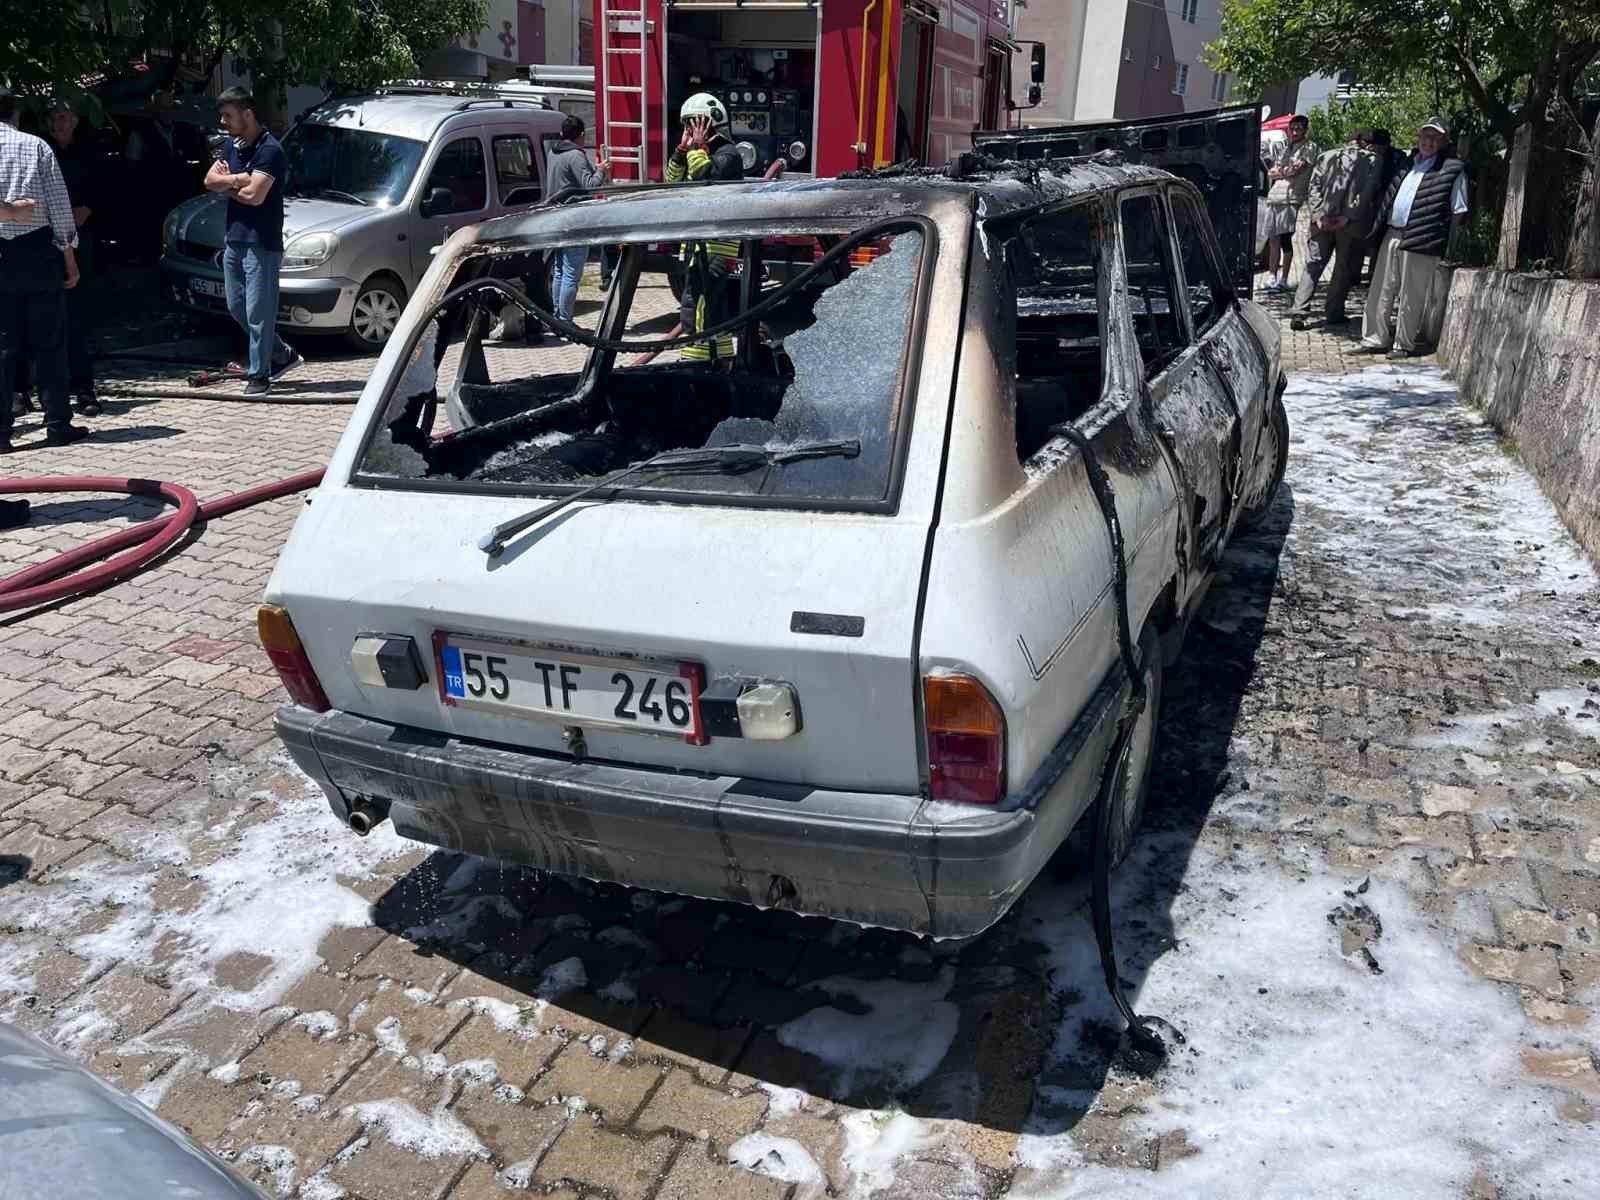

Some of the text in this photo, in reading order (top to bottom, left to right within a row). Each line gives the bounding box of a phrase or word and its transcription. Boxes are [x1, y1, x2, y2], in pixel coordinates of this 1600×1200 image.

[446, 674, 462, 689] TR
[464, 653, 690, 725] 55 TF 246
